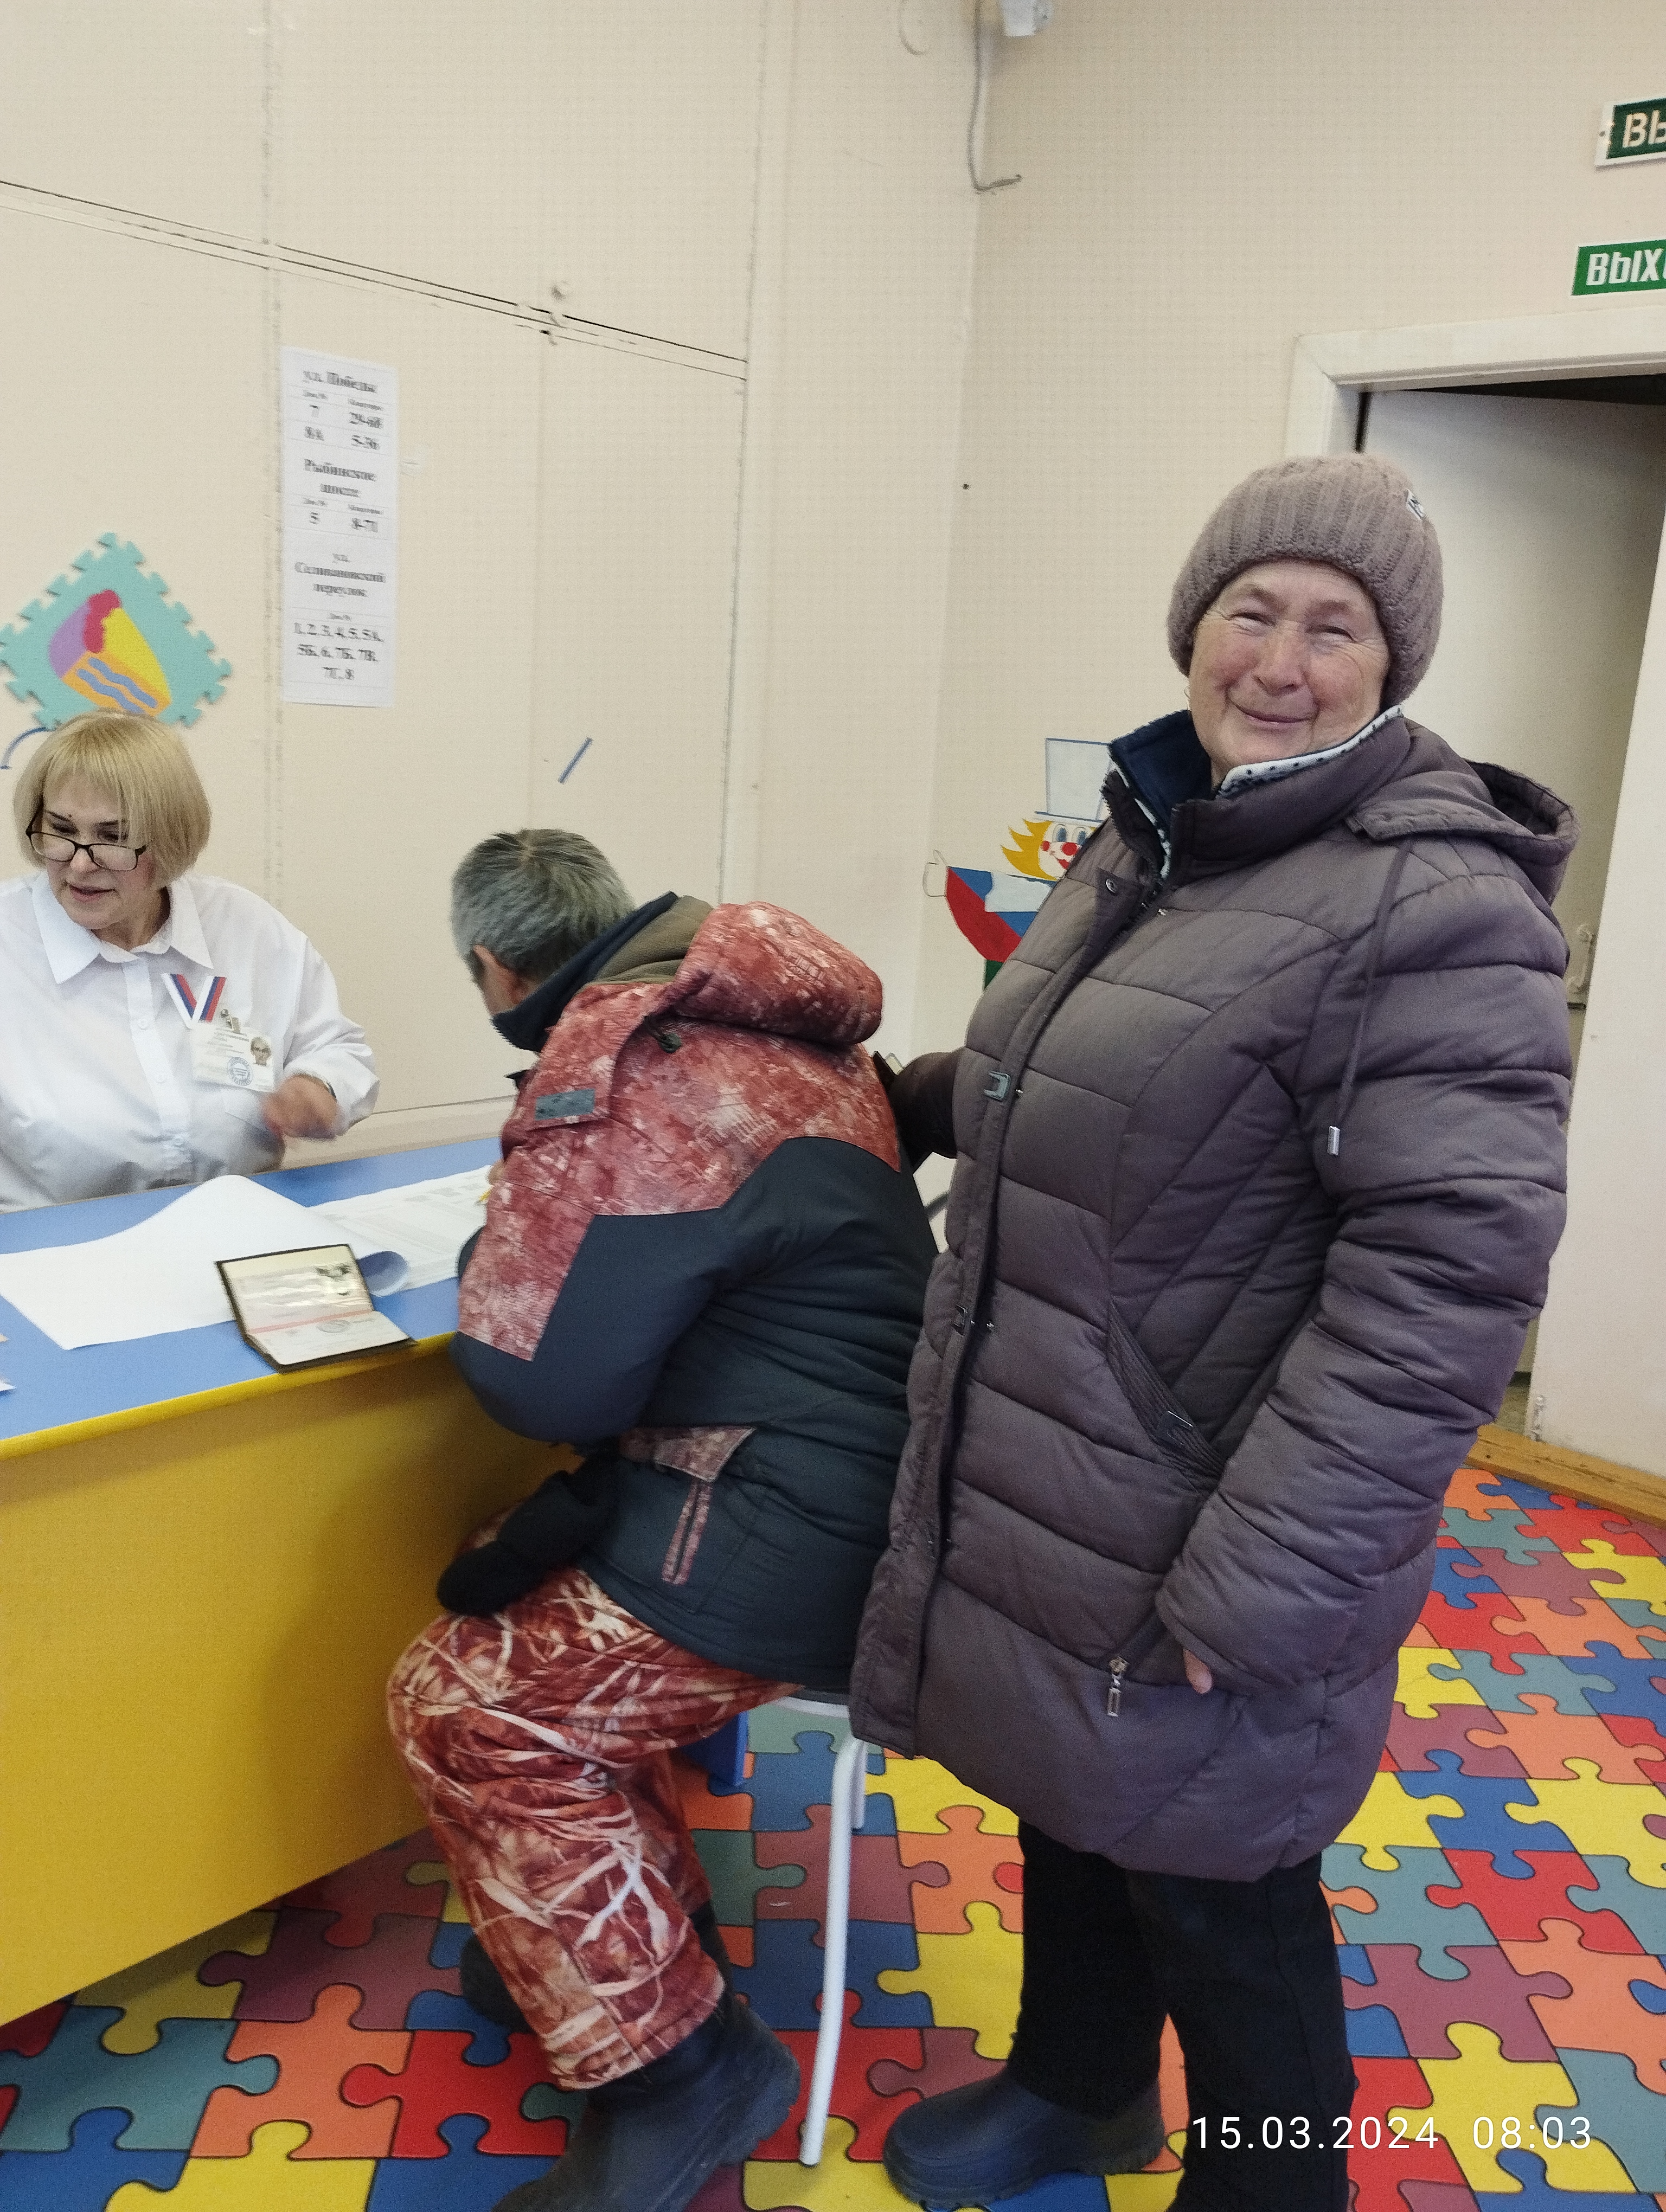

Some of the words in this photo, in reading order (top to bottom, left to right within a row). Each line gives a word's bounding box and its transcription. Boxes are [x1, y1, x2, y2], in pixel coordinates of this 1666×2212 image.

[1586, 248, 1666, 285] ВЫХ
[303, 370, 324, 384] ул.
[326, 371, 377, 393] Победы
[304, 458, 377, 481] Рыбинское
